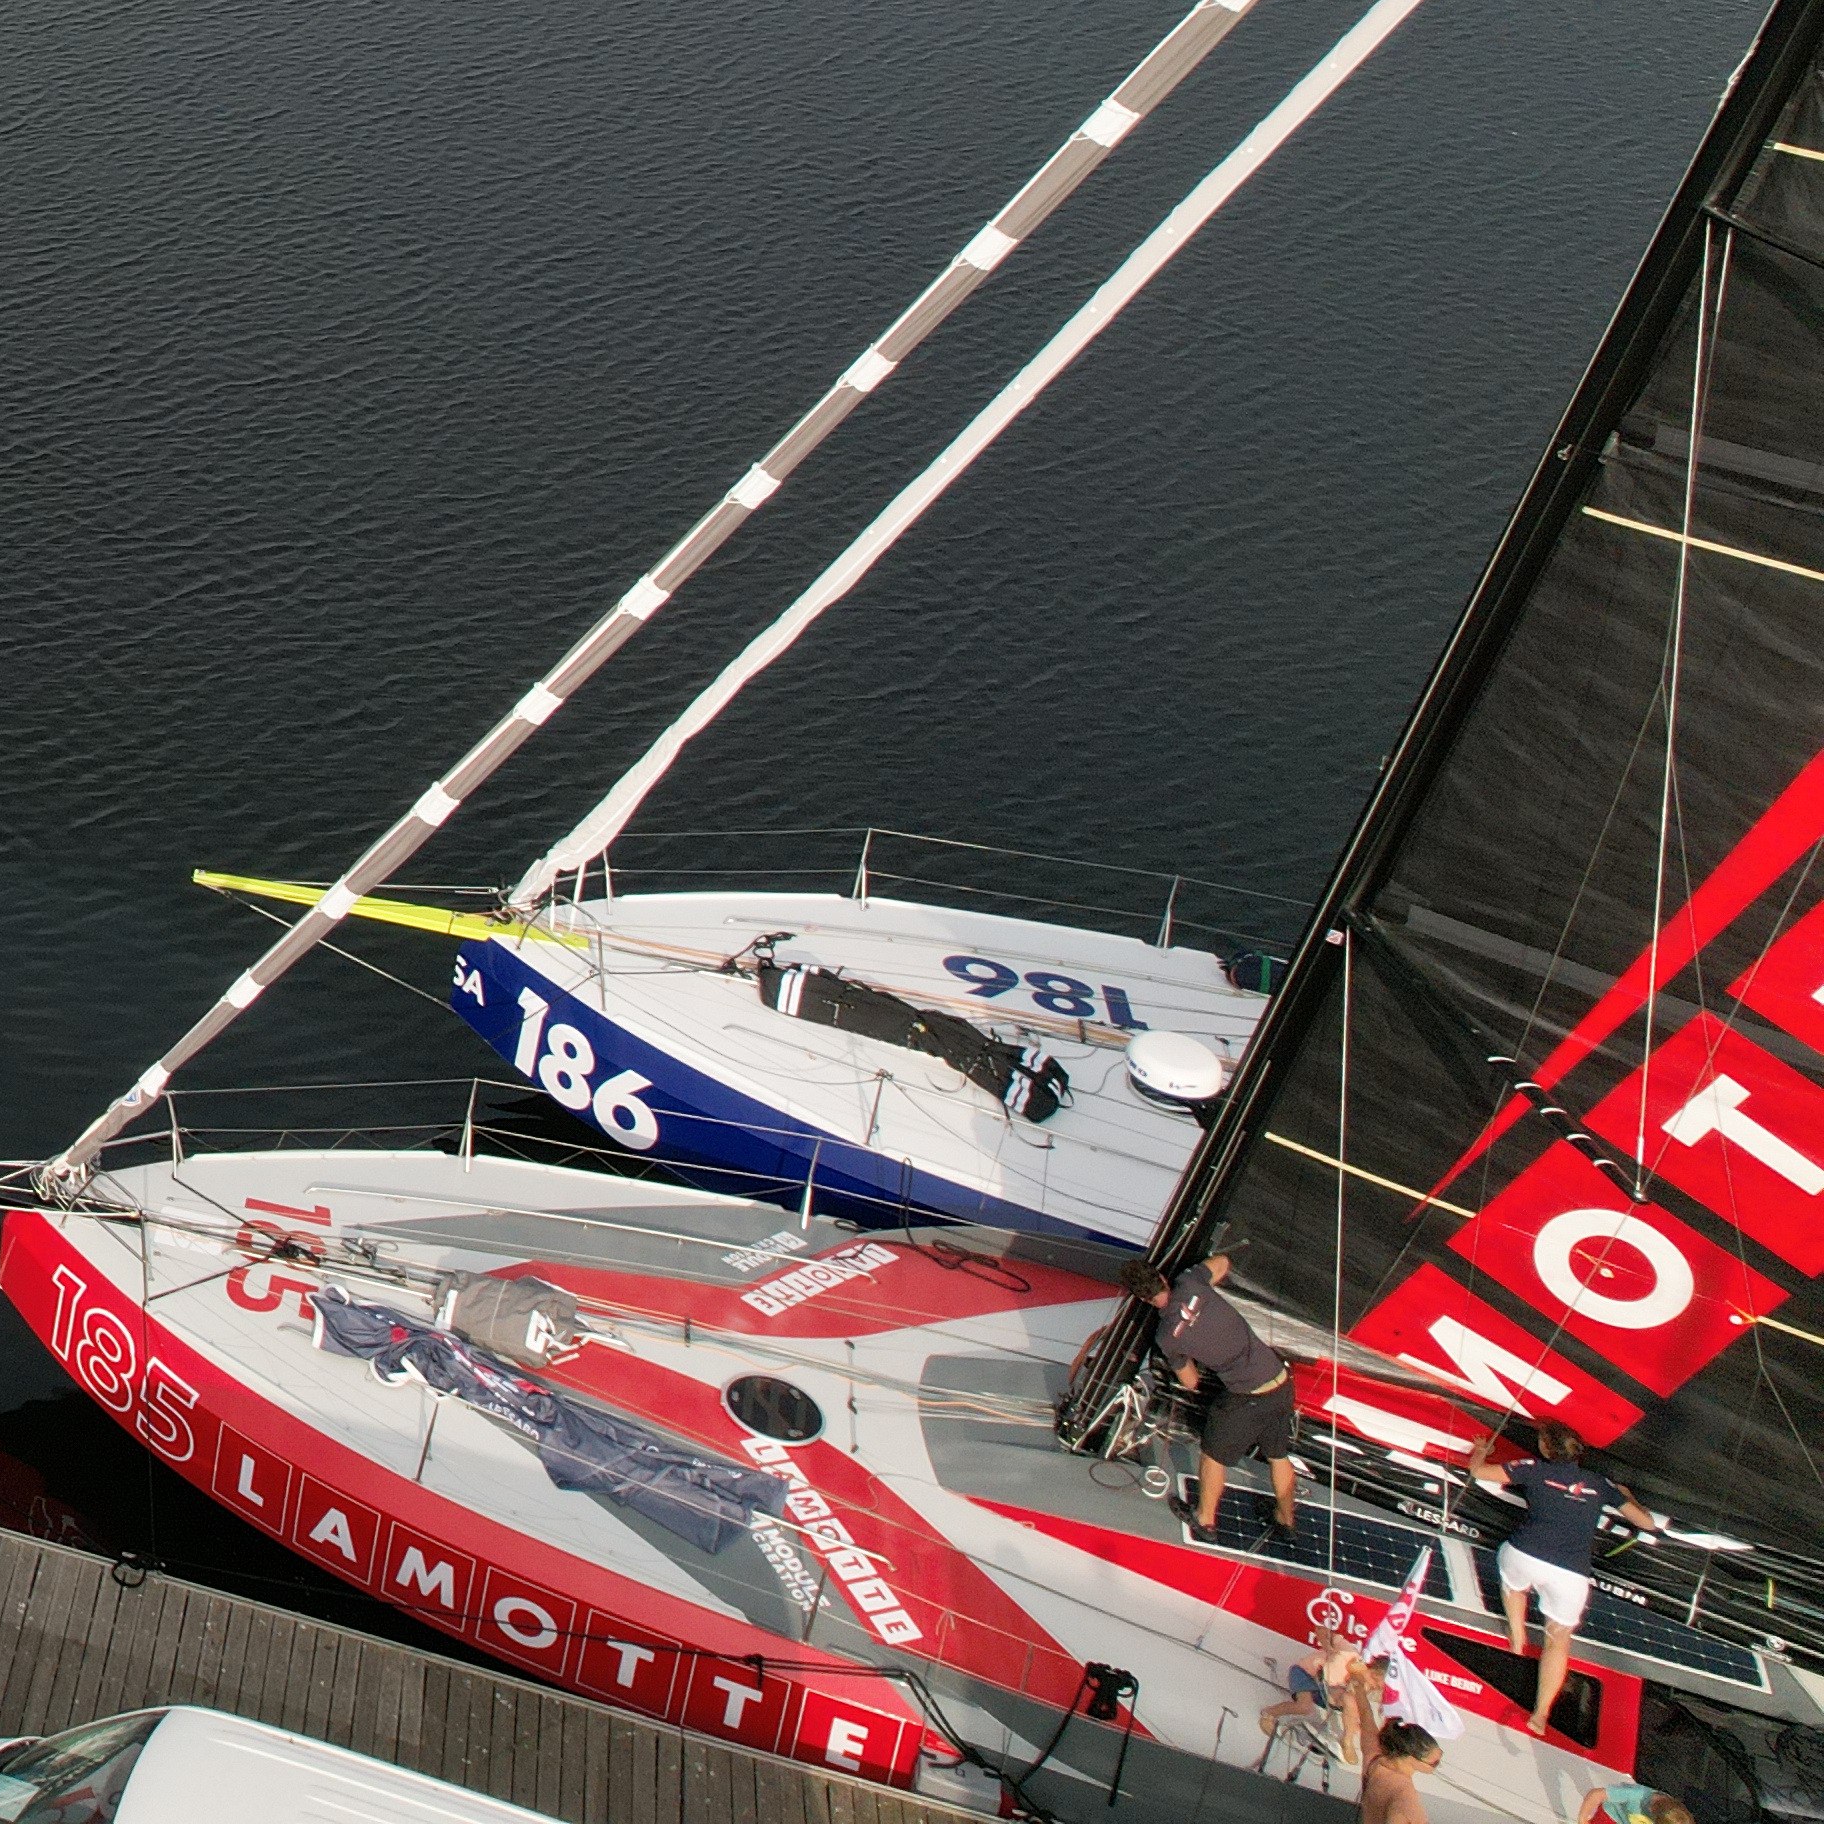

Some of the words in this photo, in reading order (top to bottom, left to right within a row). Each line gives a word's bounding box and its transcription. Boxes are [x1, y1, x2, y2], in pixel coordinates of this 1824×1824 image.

[942, 955, 1149, 1030] 186
[514, 986, 660, 1151] 186
[51, 1263, 200, 1462] 185
[237, 1454, 871, 1772] LAMOTTE
[763, 1524, 832, 1608] MODULE
[1450, 1674, 1484, 1695] BERRY
